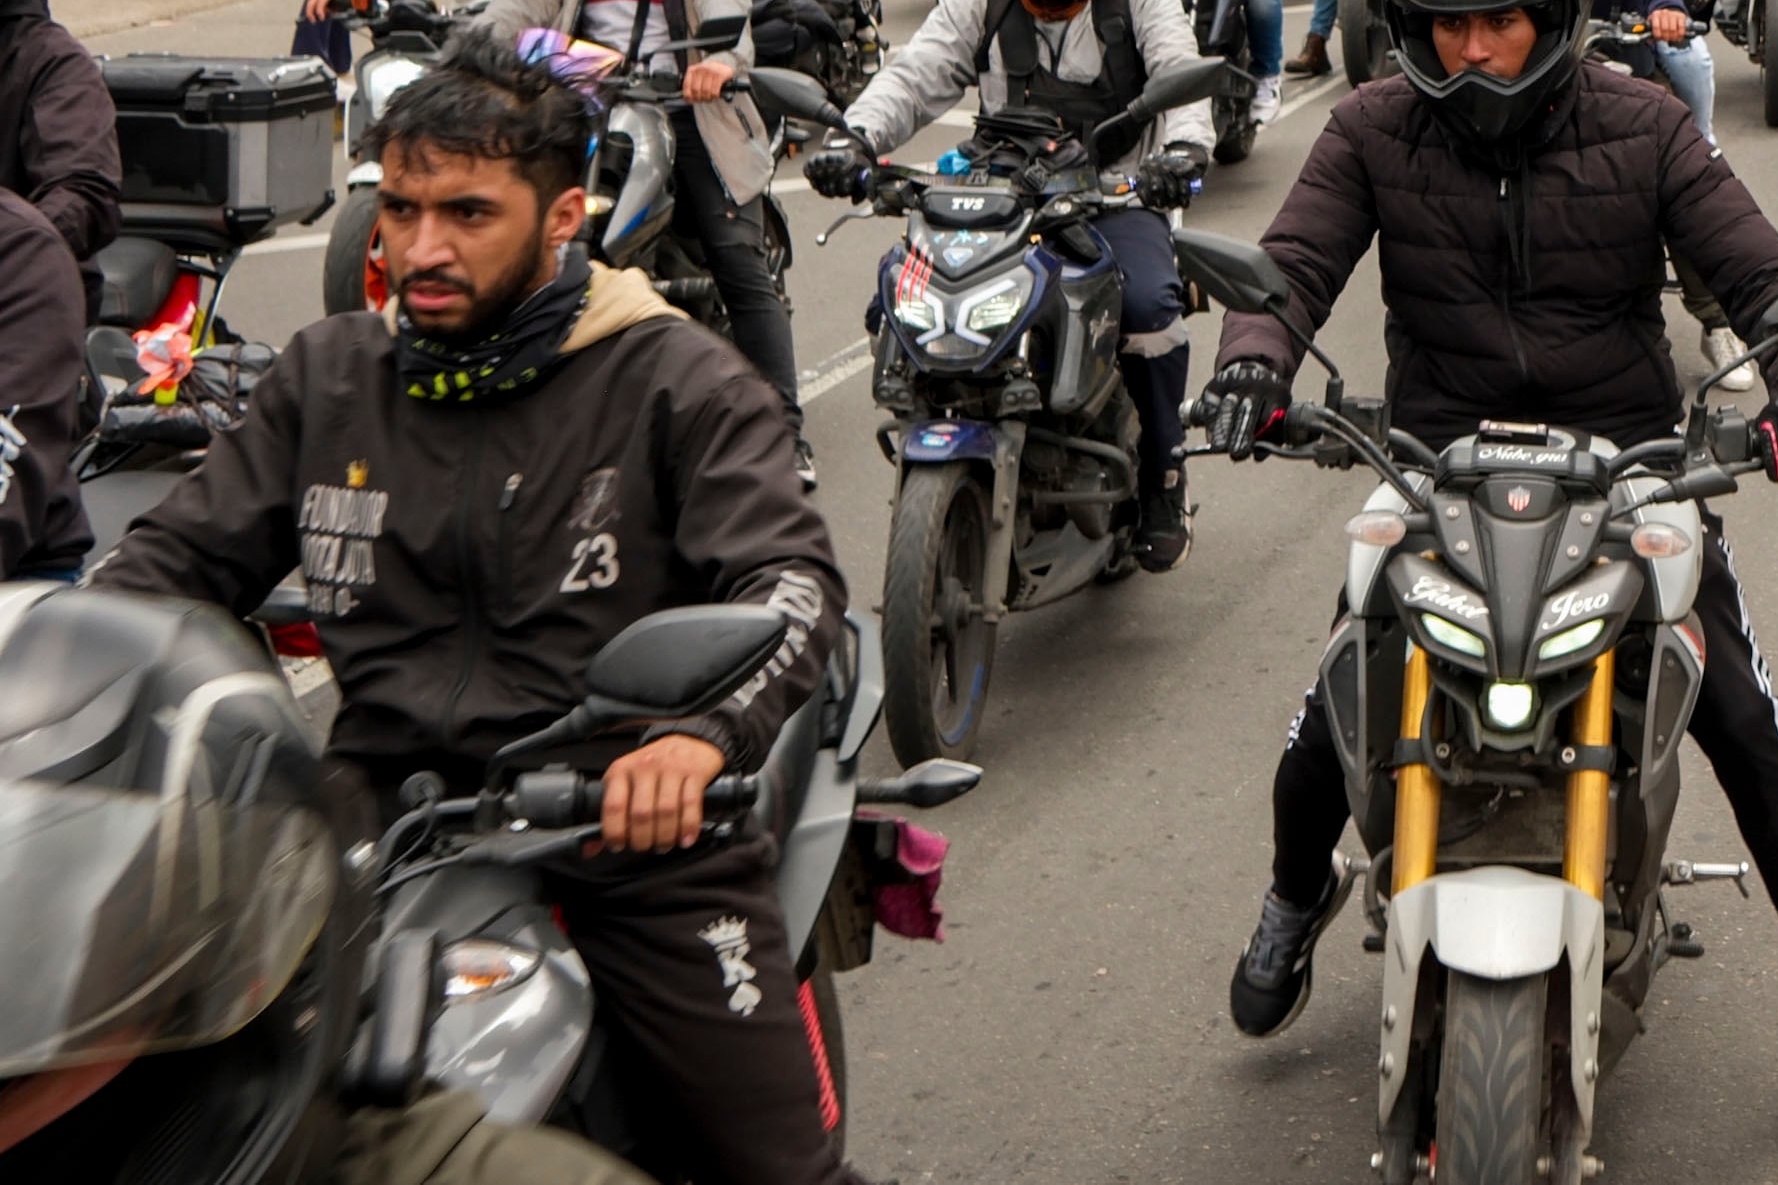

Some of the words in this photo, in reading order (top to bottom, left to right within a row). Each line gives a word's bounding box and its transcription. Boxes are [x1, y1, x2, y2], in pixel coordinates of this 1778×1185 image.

[951, 197, 986, 211] TVS
[559, 532, 621, 593] 23
[1541, 589, 1610, 631] Jero
